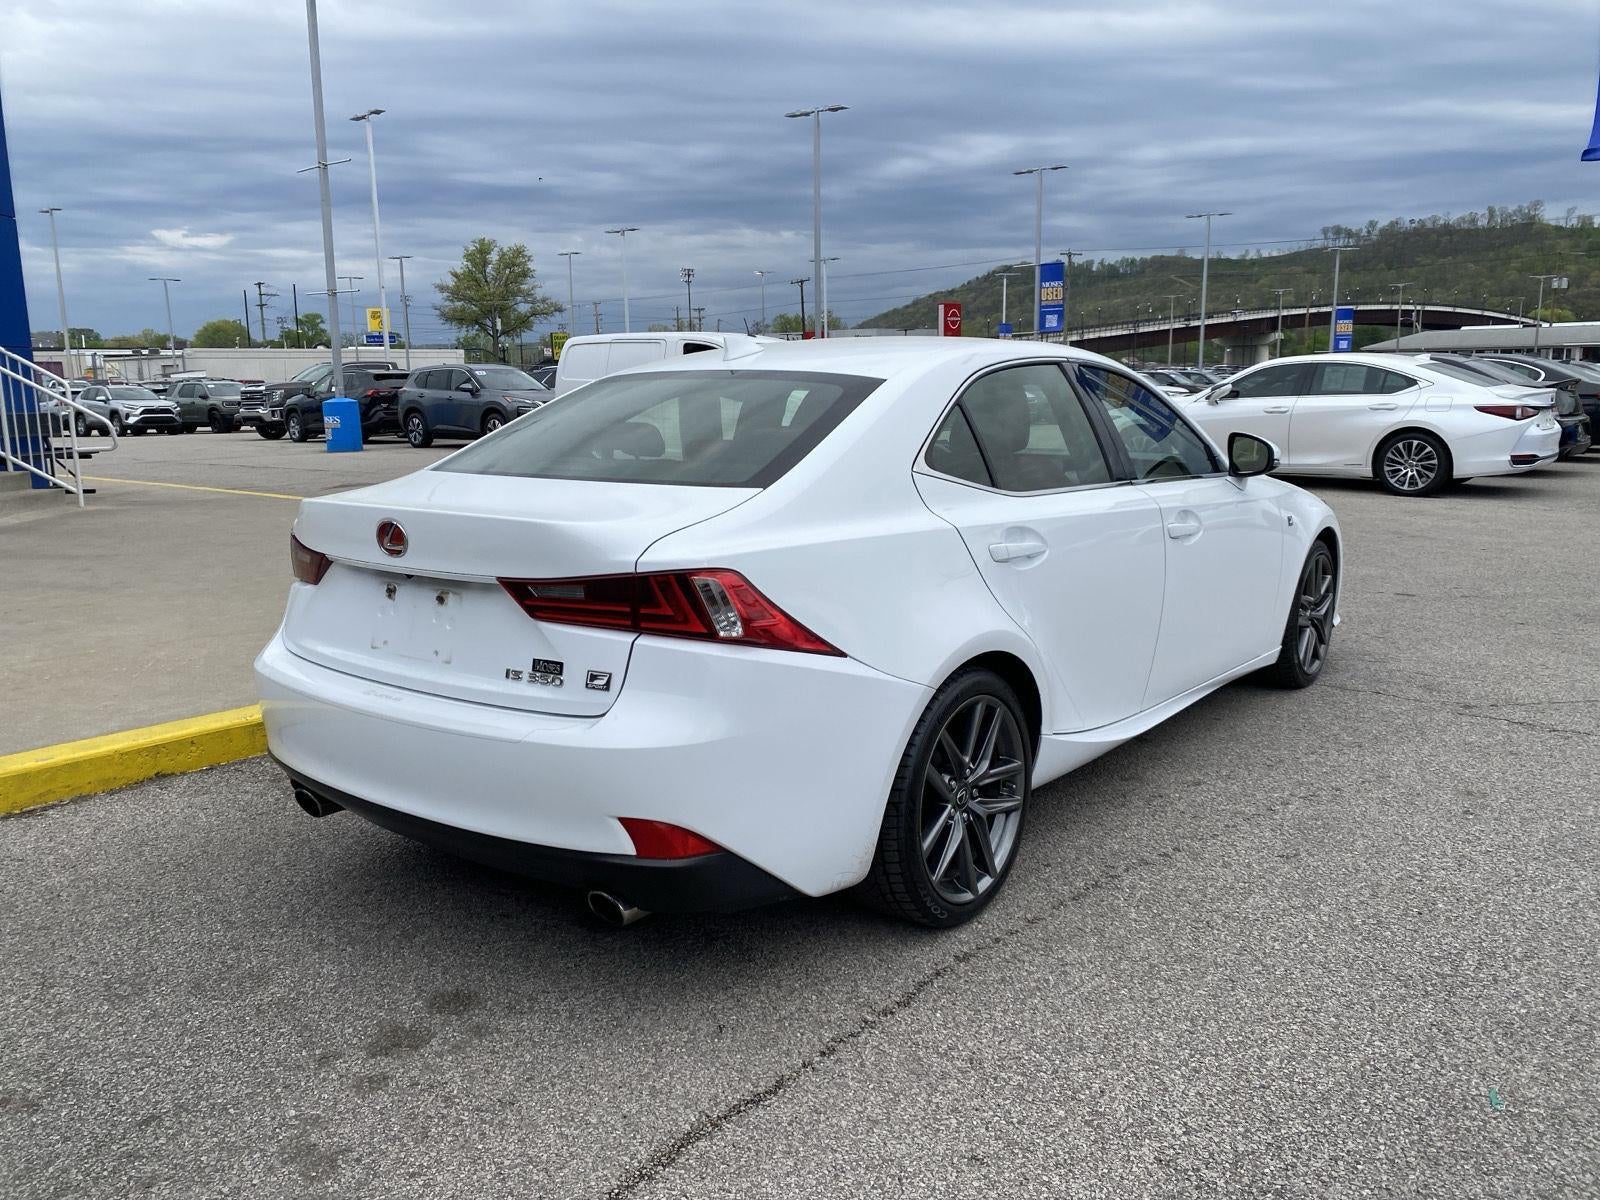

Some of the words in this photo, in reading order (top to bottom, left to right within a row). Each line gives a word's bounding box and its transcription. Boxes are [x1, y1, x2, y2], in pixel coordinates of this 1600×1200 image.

[1041, 287, 1063, 300] USED
[505, 668, 523, 681] IS
[527, 672, 564, 687] 350
